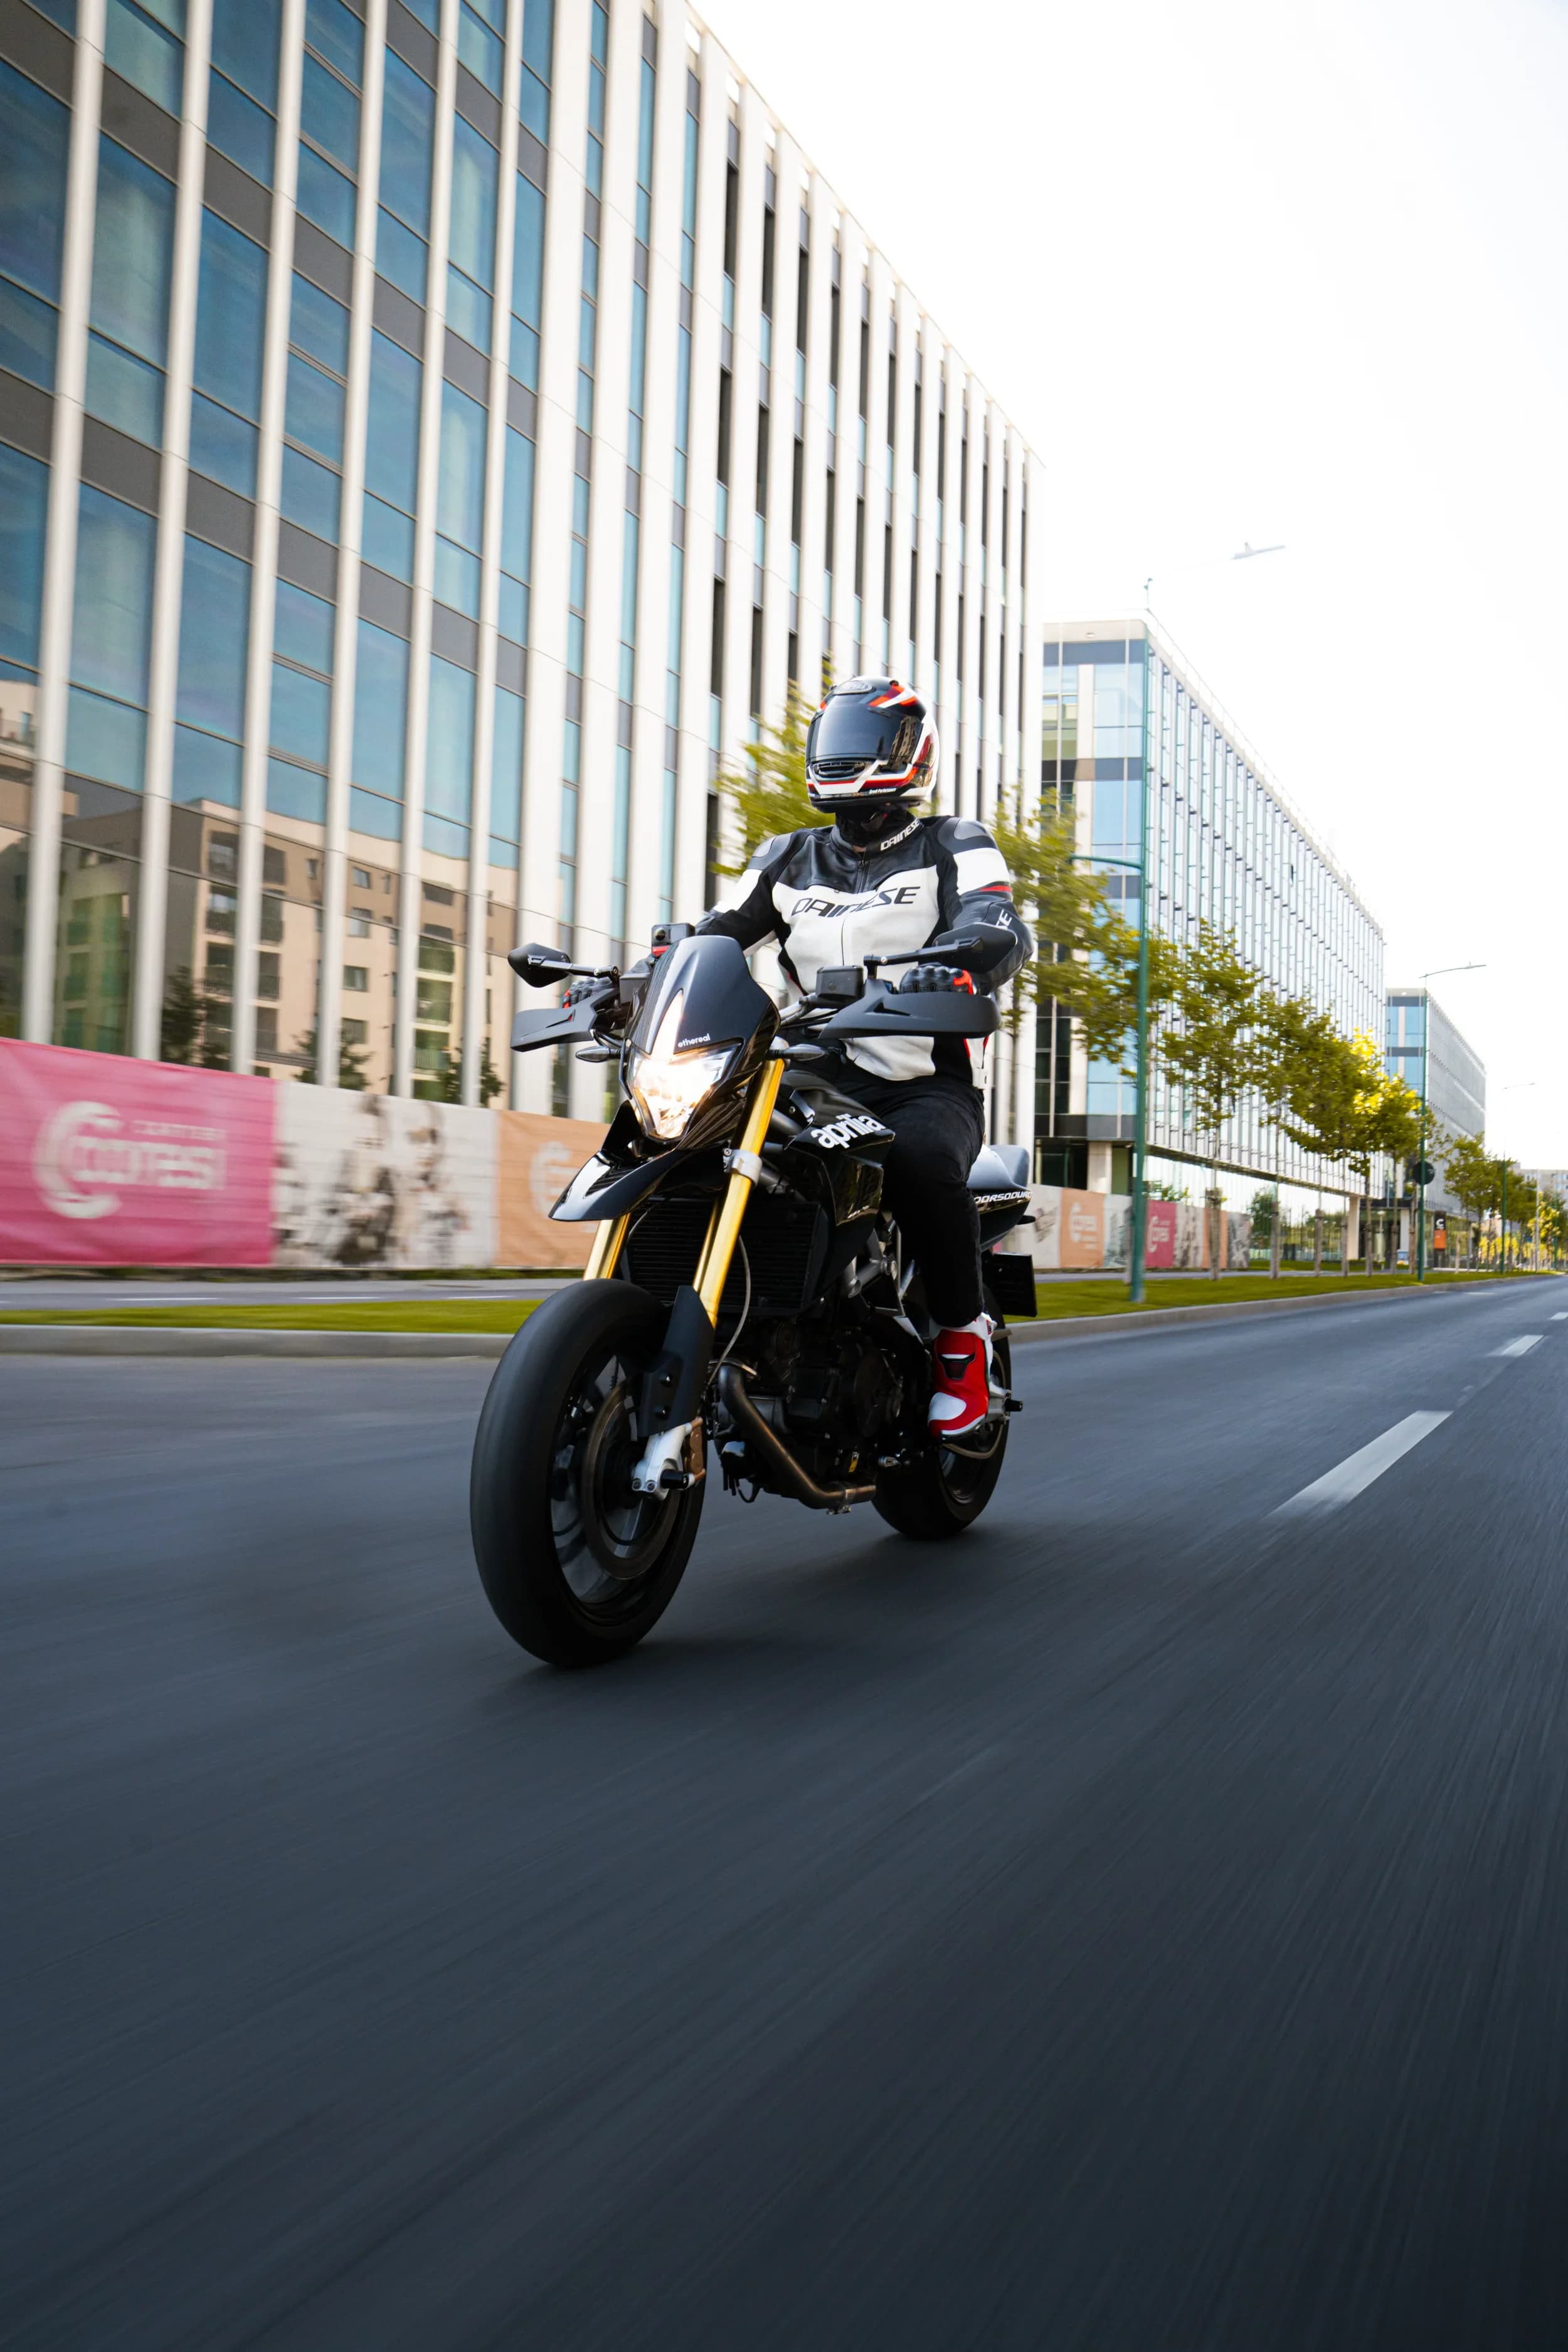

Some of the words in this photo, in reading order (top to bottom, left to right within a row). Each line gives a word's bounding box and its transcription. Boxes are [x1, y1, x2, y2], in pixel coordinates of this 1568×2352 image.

[880, 817, 920, 851] DAINESE
[791, 886, 921, 918] DAINESE
[677, 1033, 711, 1047] ethereal
[810, 1113, 886, 1148] aprilia
